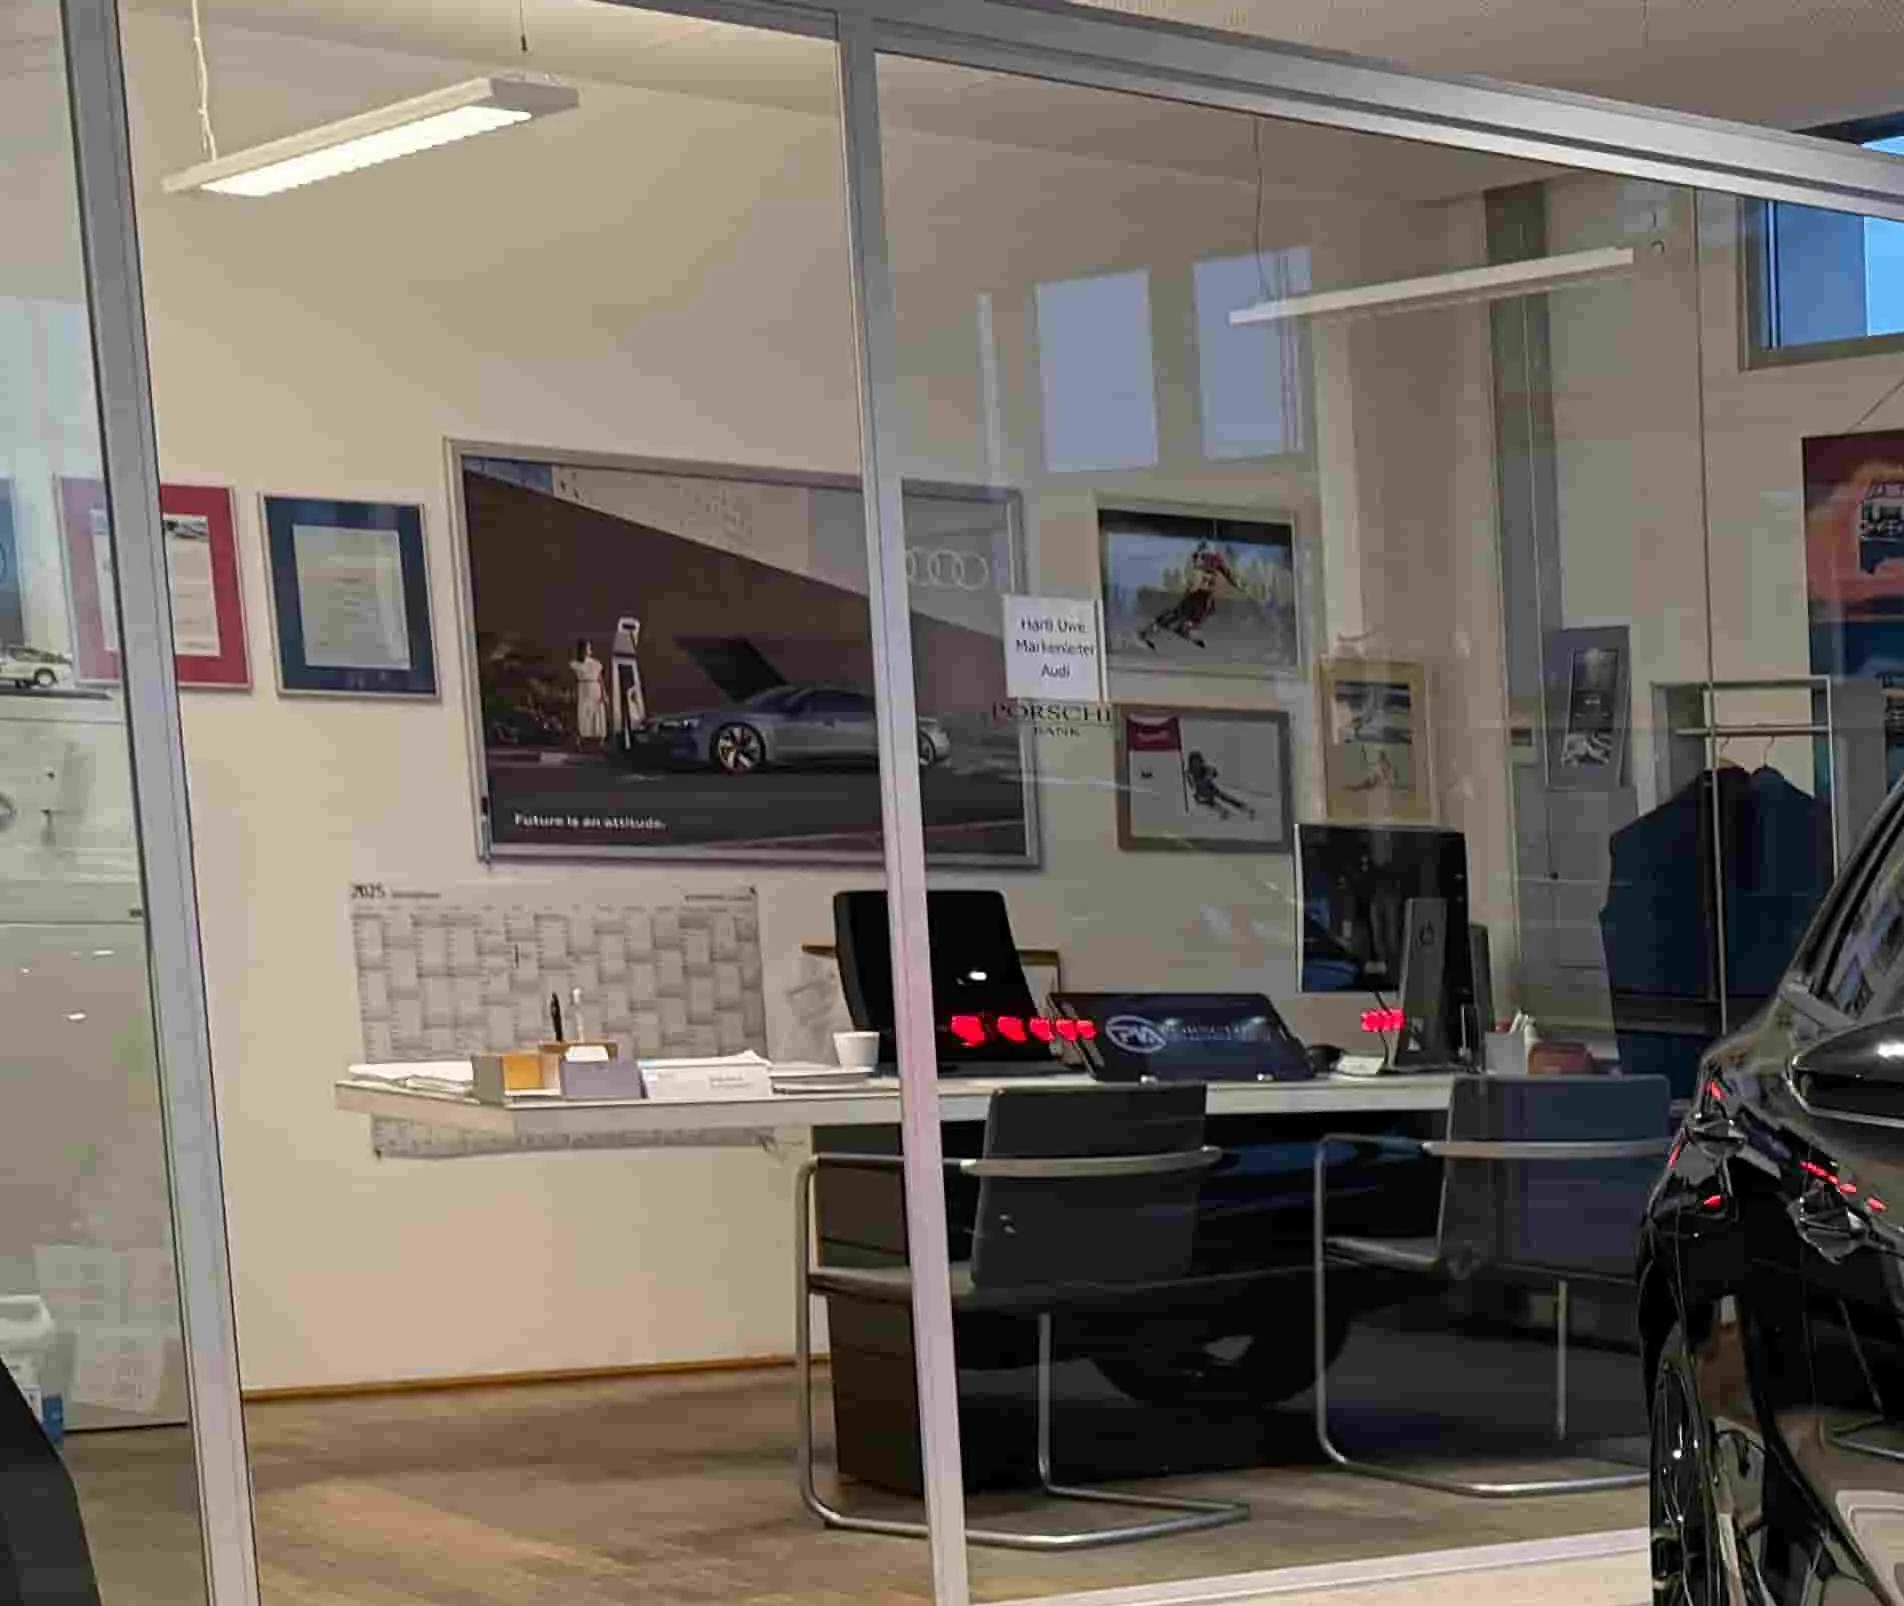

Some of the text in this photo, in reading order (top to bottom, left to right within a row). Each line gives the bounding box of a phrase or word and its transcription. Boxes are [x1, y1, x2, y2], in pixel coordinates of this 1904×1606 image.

[1041, 664, 1071, 678] Audi
[514, 814, 565, 827] Future
[352, 882, 385, 898] 2025
